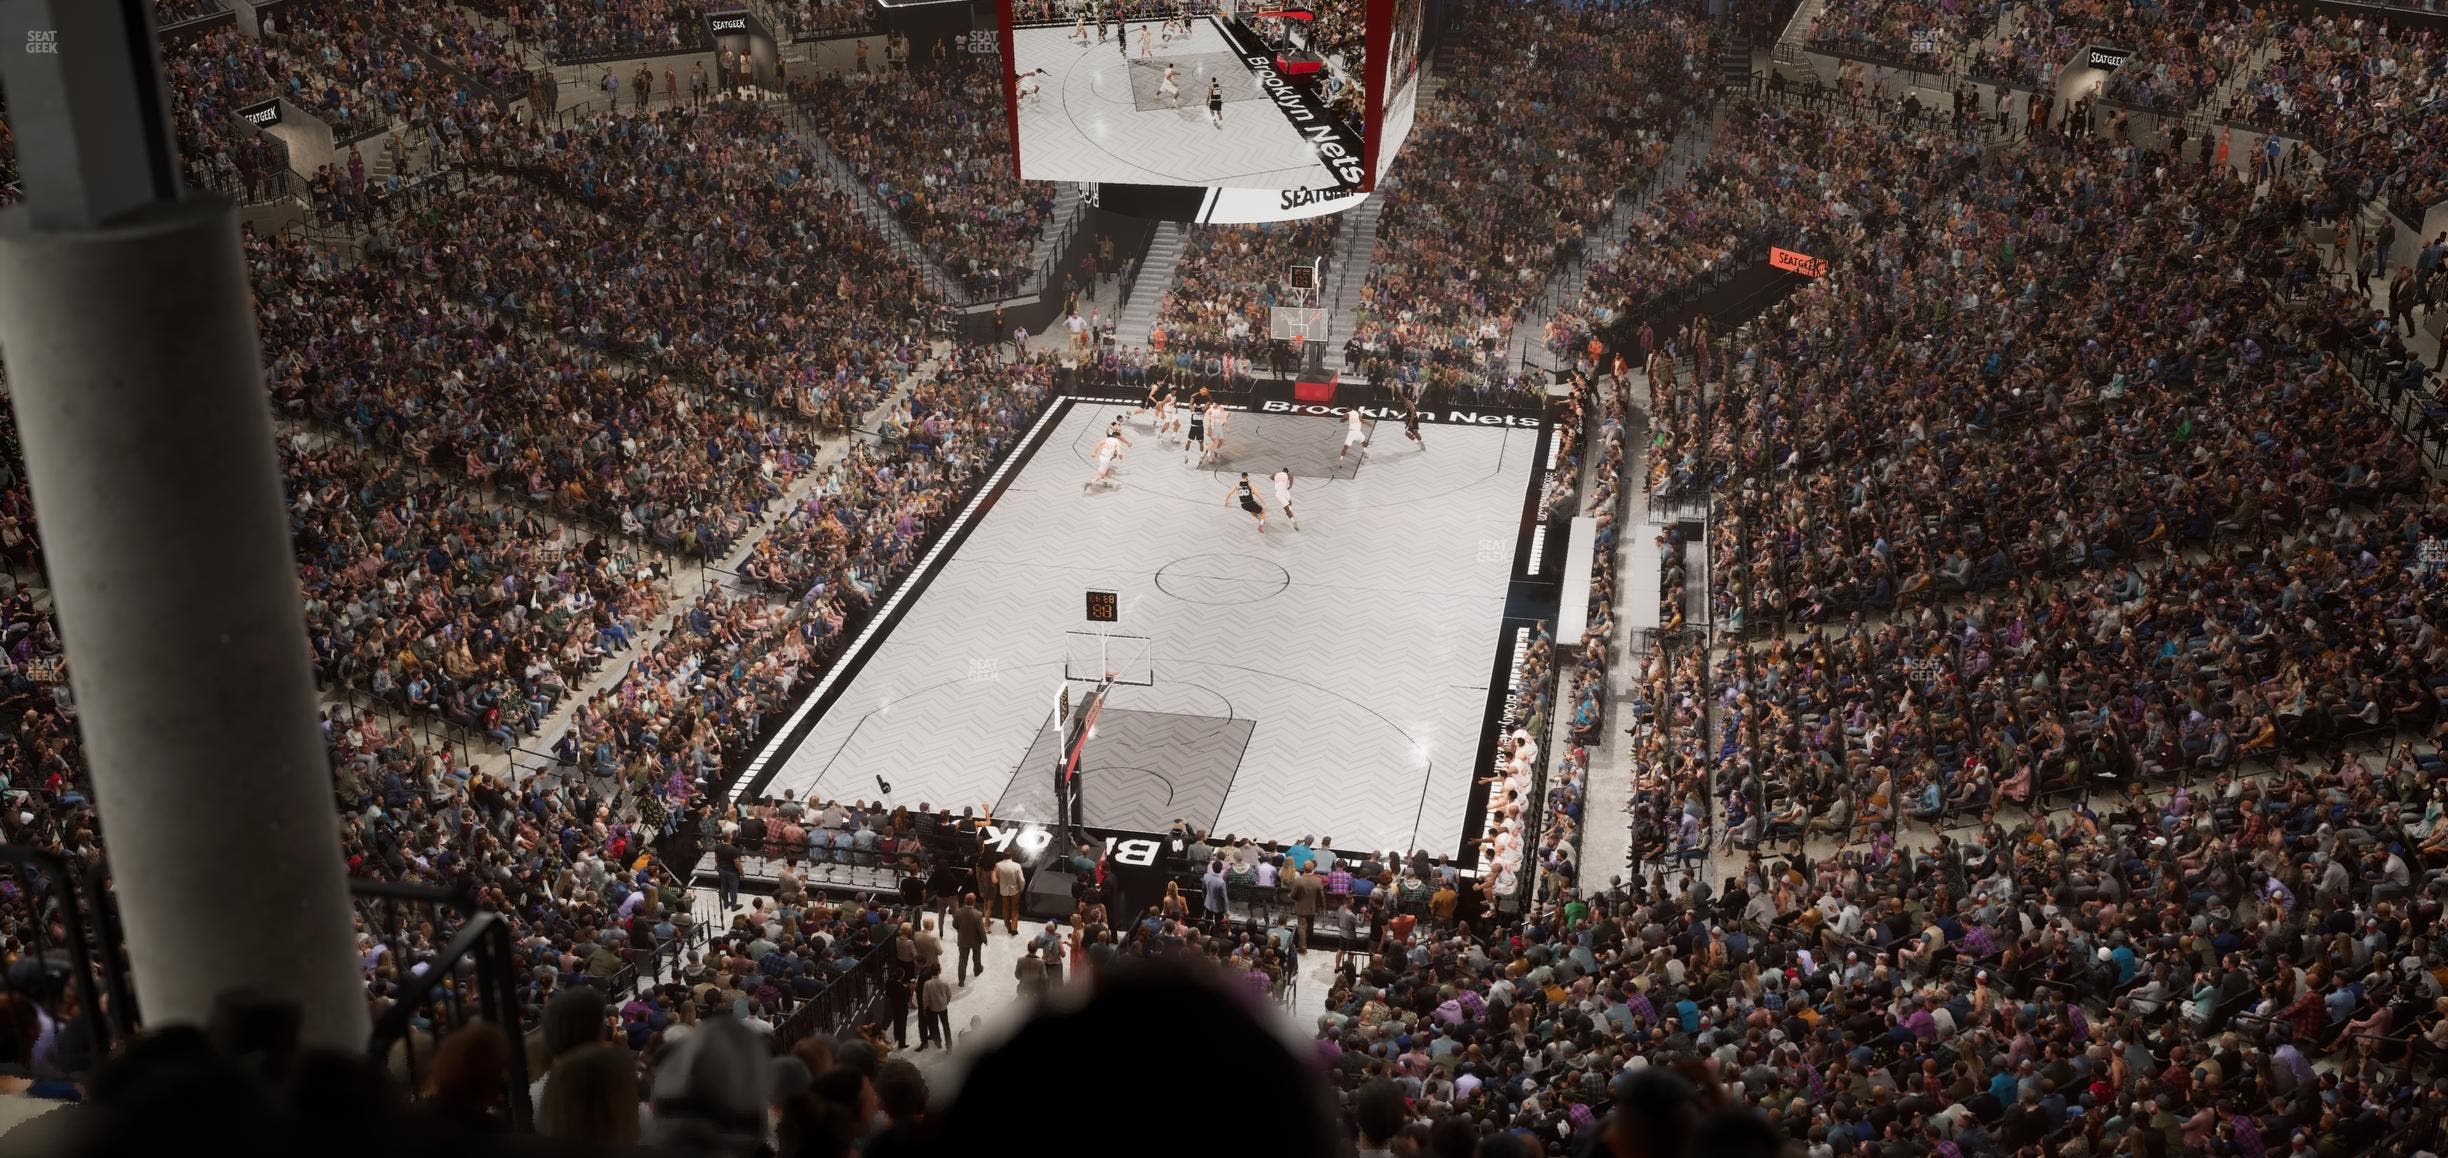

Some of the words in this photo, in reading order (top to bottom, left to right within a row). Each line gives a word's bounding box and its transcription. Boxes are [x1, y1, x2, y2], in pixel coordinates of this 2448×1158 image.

[712, 18, 746, 31] SEATGEEK
[1247, 56, 1315, 121] Brooklyn
[1304, 124, 1365, 184] Nets
[1449, 410, 1541, 427] Nets
